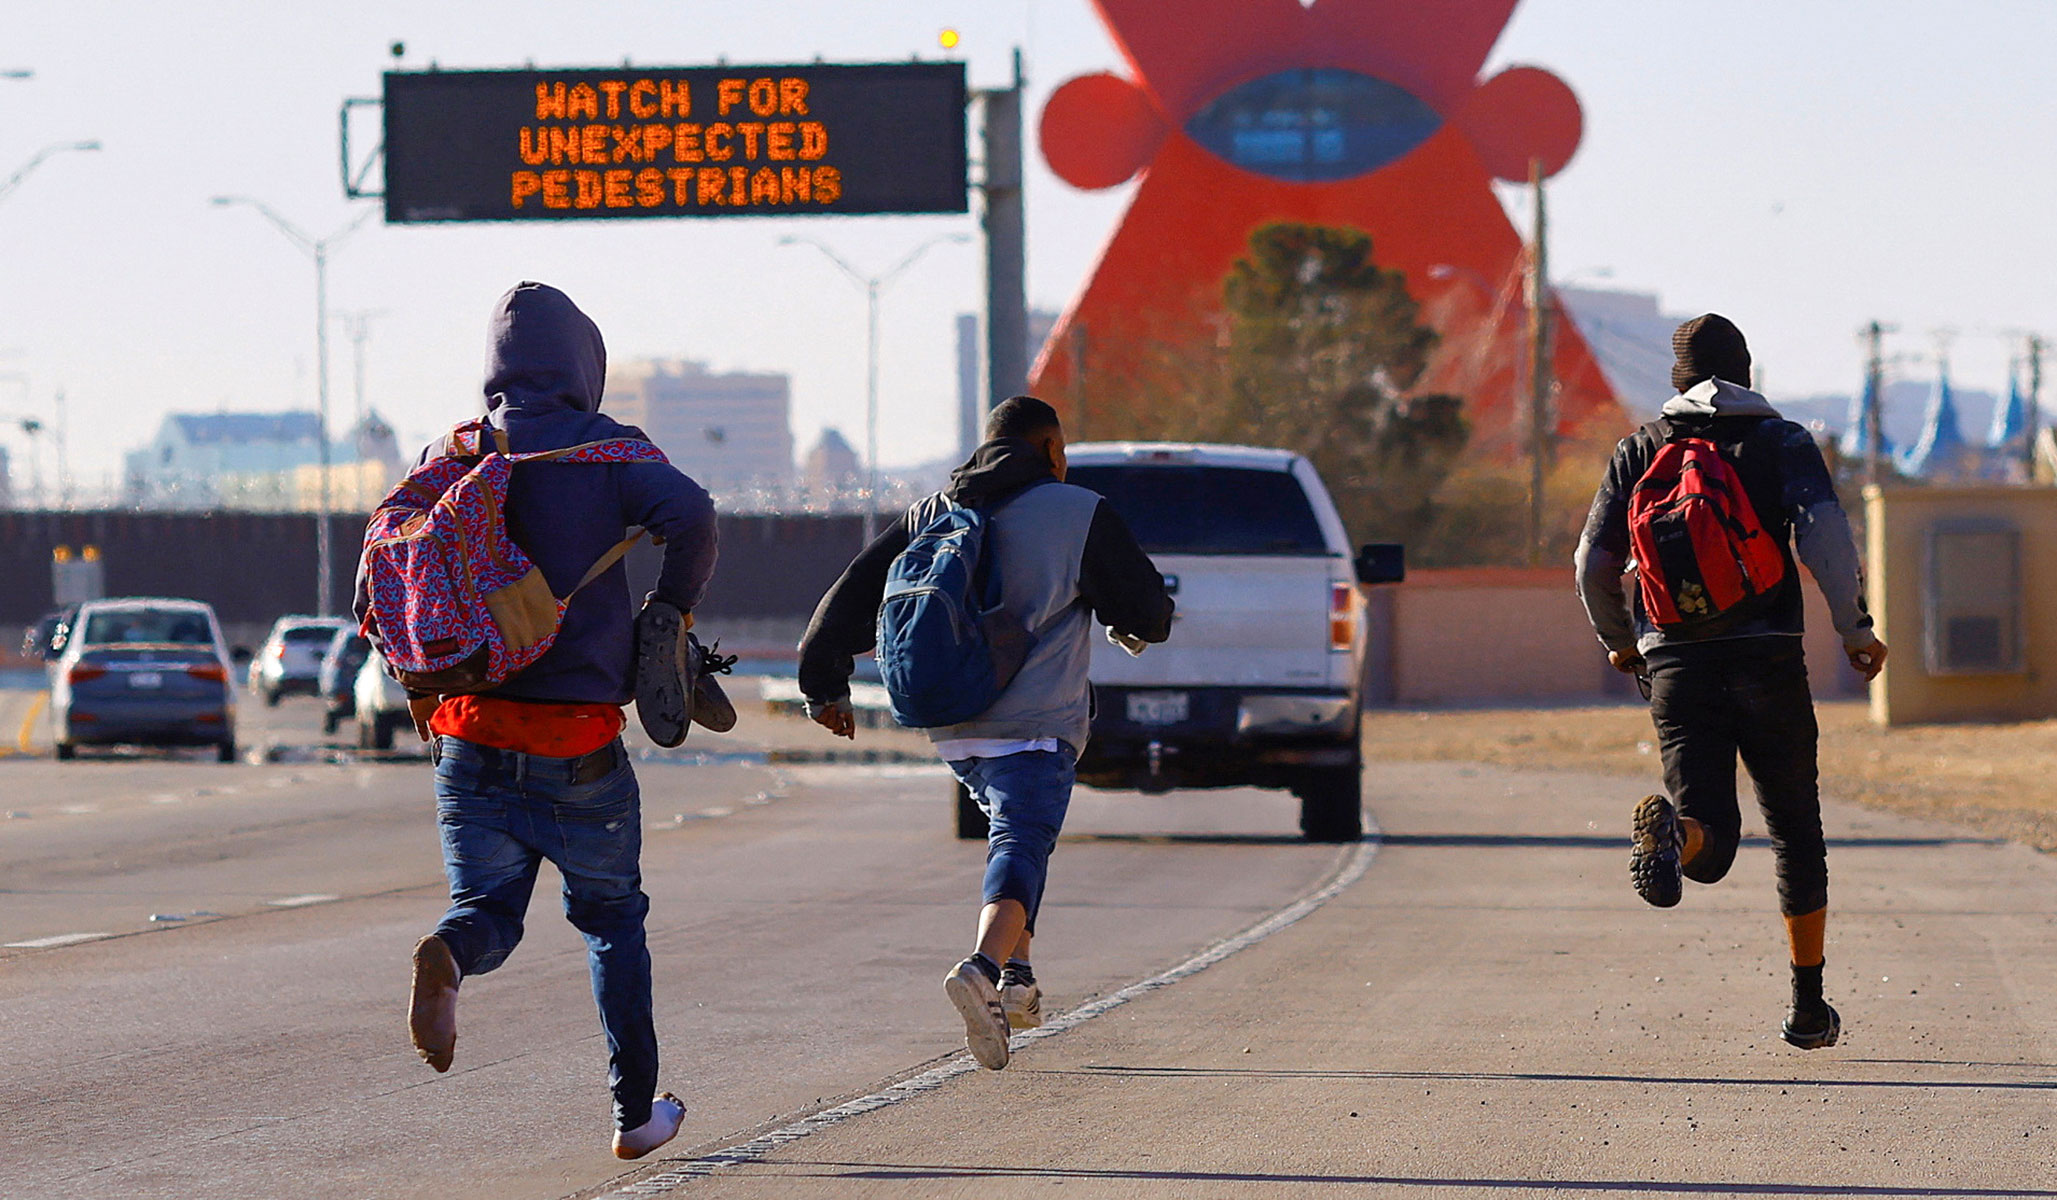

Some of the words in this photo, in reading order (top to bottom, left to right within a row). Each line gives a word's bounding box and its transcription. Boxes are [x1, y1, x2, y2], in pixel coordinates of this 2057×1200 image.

[535, 78, 692, 121] WATCH
[716, 77, 810, 118] FOR
[519, 121, 828, 166] UNEXPECTED
[511, 165, 842, 210] PEDESTRIANS
